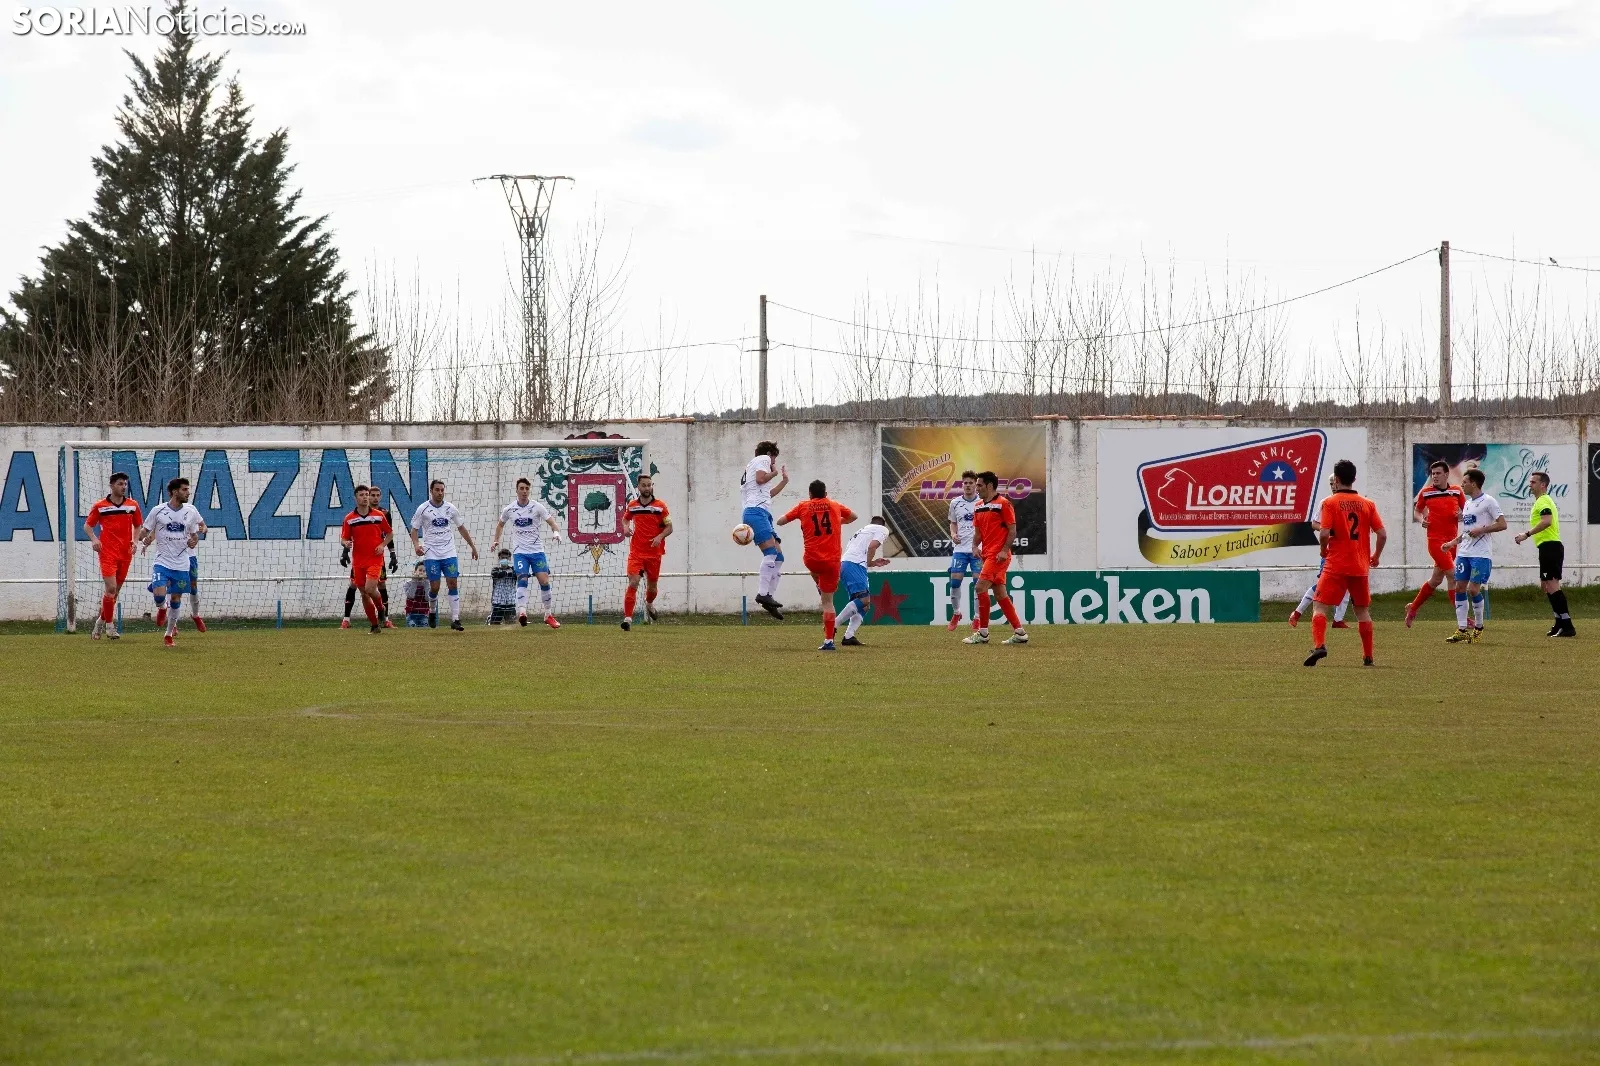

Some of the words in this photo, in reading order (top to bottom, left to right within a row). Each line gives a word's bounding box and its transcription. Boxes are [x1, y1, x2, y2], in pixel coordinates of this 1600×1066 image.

[920, 478, 1032, 500] MAEO
[1186, 481, 1297, 511] LLORENTE
[1499, 465, 1569, 500] Lara
[811, 511, 833, 537] 14
[1347, 512, 1359, 540] 2
[1170, 544, 1210, 559] Sabor
[1213, 545, 1222, 558] y
[1226, 530, 1280, 552] tradición
[517, 561, 523, 569] 5
